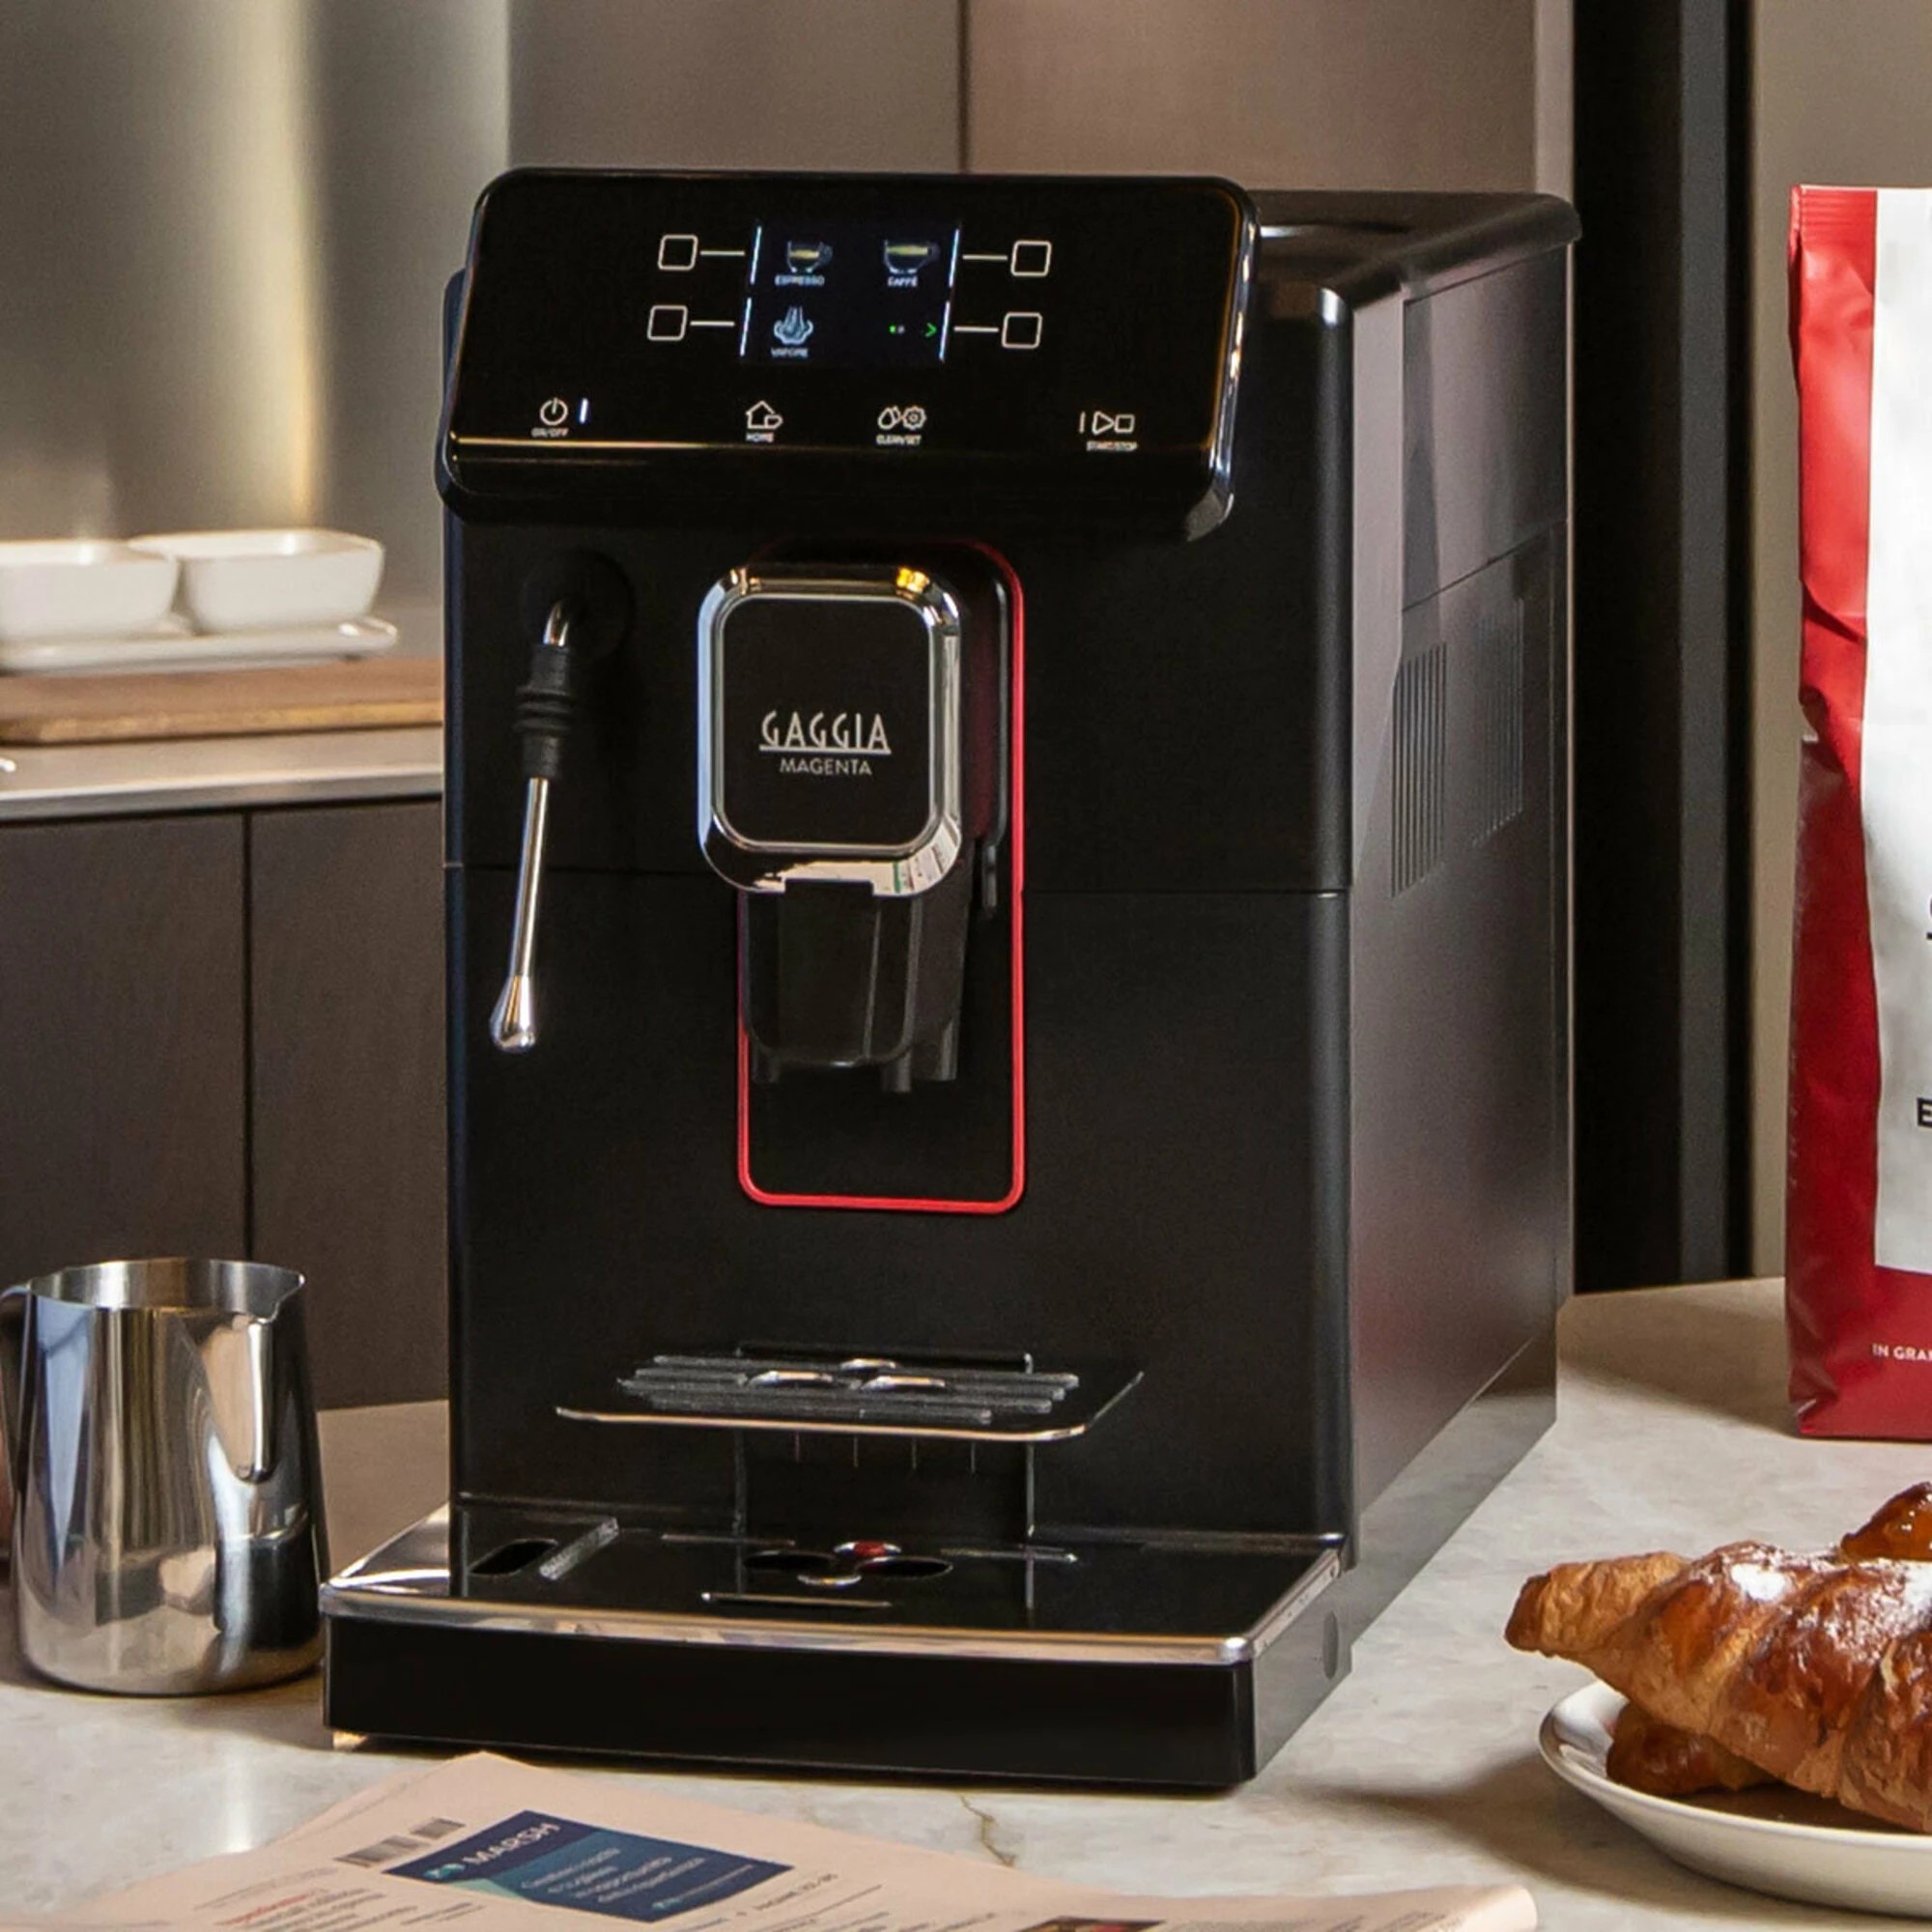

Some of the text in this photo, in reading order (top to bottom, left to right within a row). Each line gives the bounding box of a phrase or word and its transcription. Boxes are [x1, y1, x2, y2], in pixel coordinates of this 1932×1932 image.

[759, 710, 892, 755] GAGGIA
[780, 756, 873, 776] MAGENTA
[1872, 1344, 1889, 1357] IN
[462, 1822, 561, 1865] MARSH
